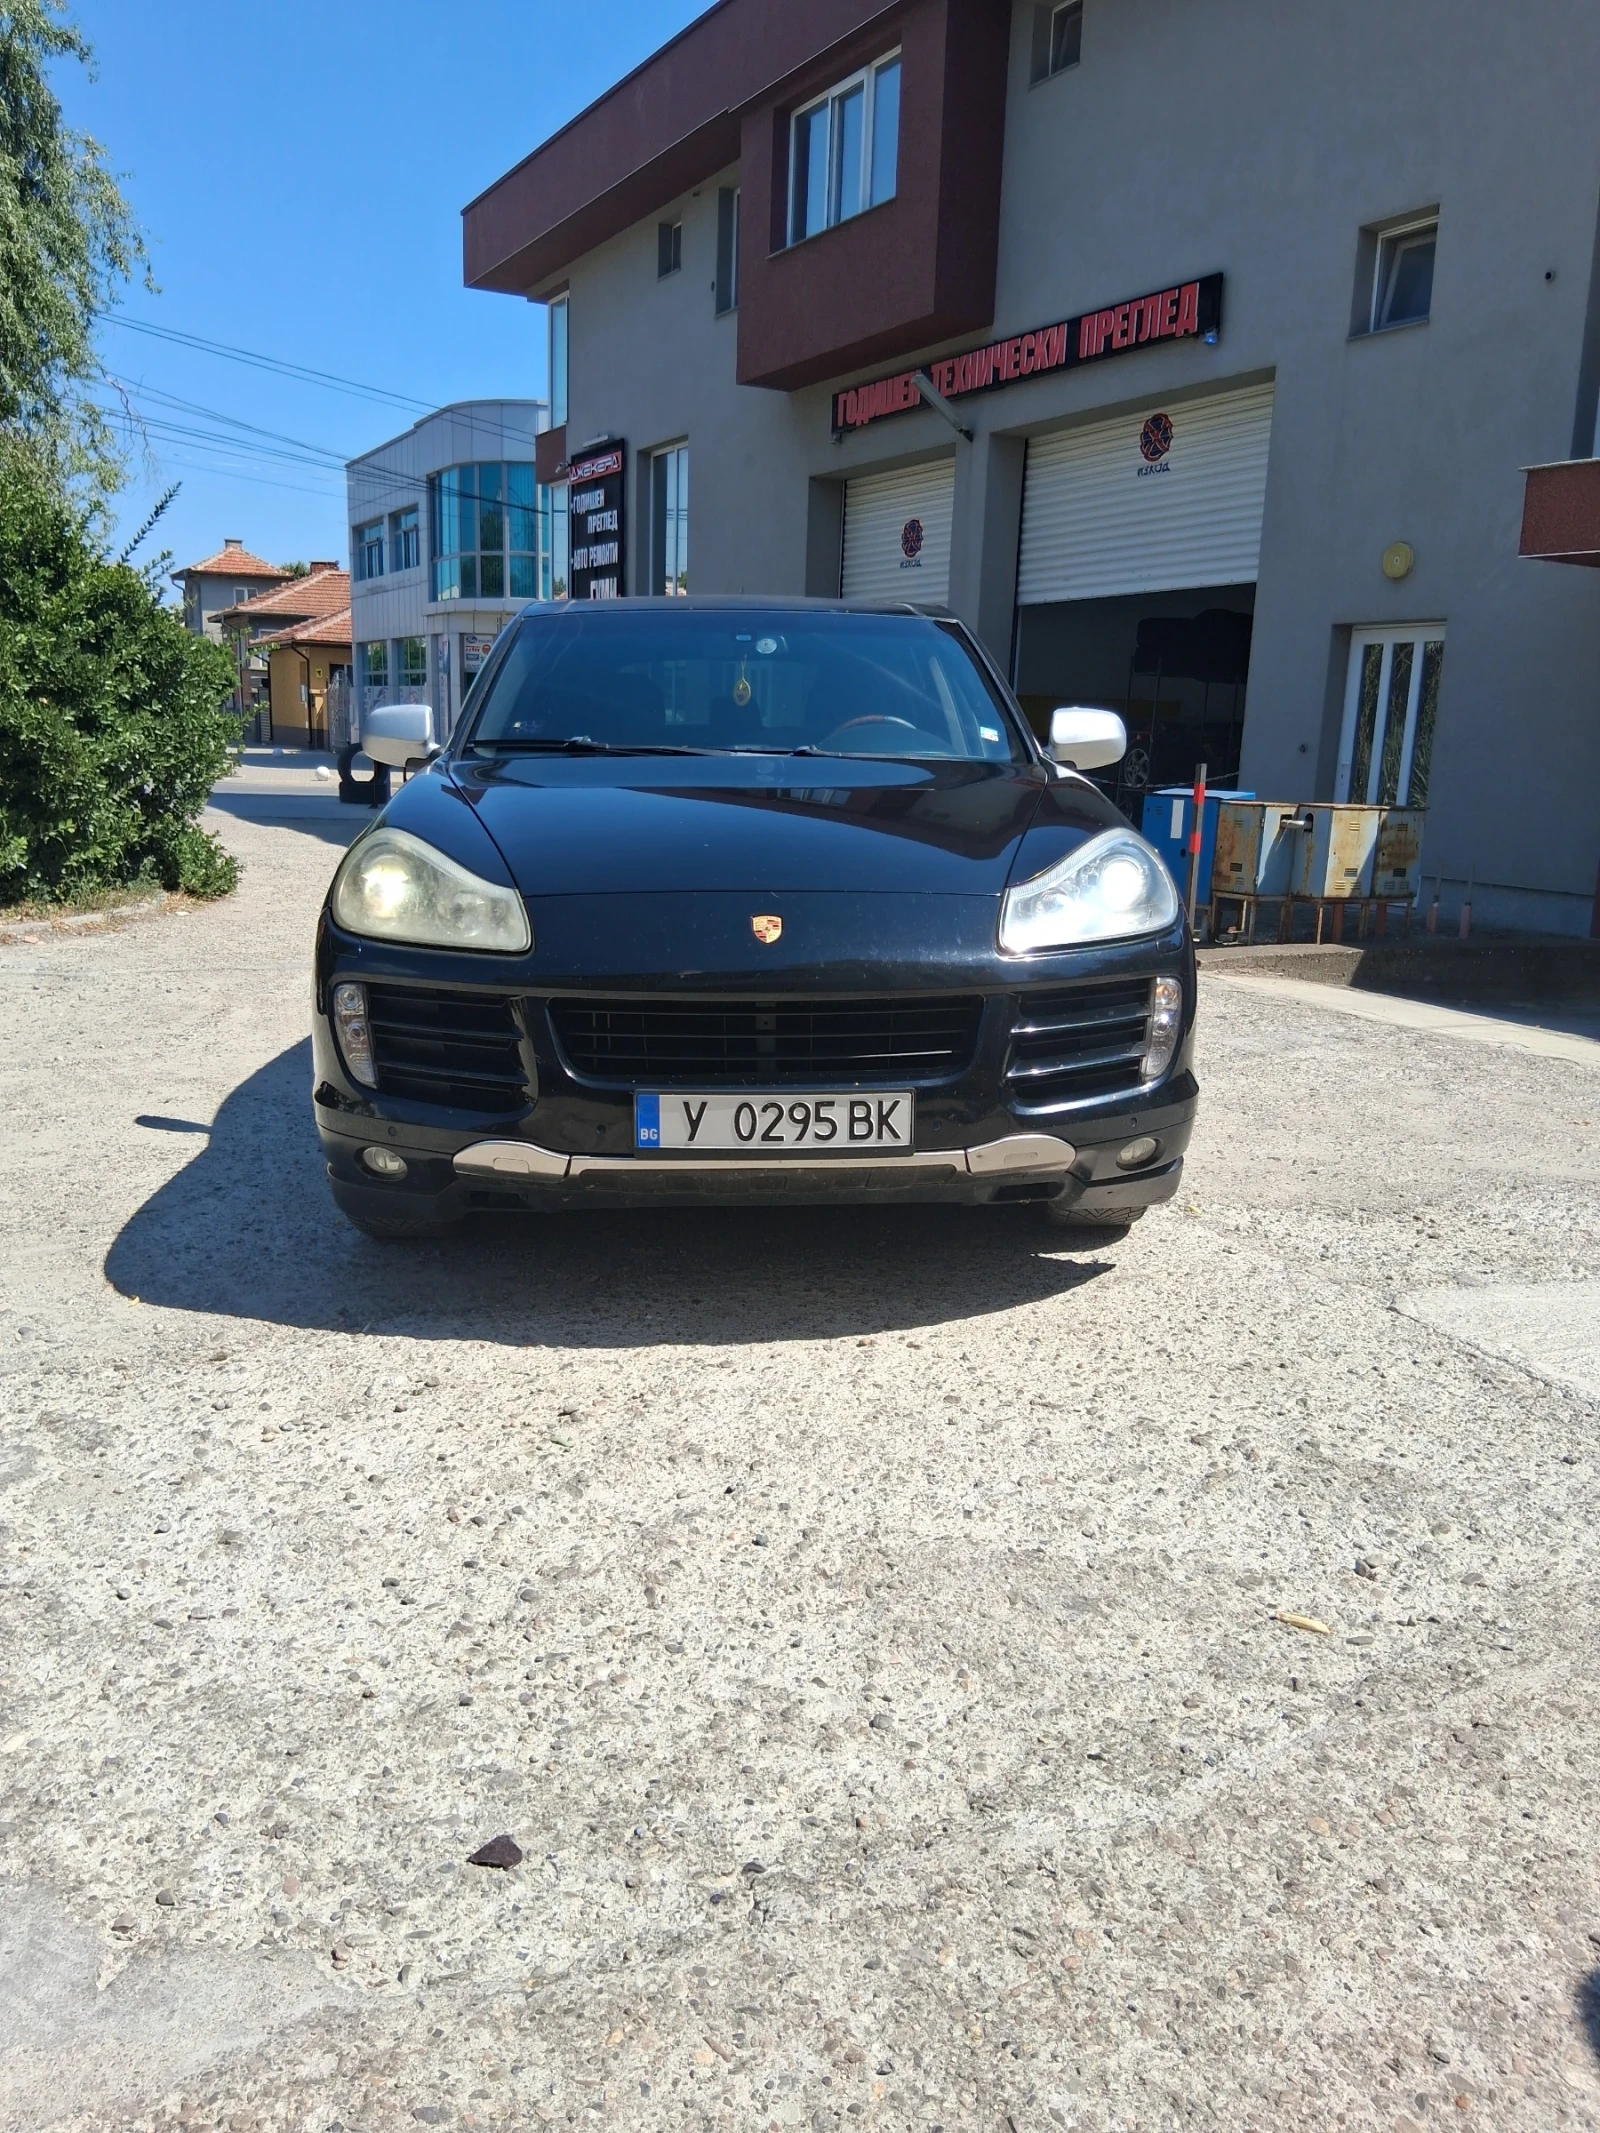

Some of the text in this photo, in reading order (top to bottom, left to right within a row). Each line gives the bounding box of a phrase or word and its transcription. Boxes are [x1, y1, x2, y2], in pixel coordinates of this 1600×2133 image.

[837, 282, 1201, 427] ГОДИШЕН ТЕХНИЧЕСКИ ПРЕГЛЕД
[573, 488, 605, 515] ГОДИШЕН
[587, 509, 619, 534] ПРЕГЛЕД
[573, 541, 619, 571] АВТО РЕМОНТИ
[640, 1128, 658, 1140] BG
[734, 1101, 838, 1141] 0295
